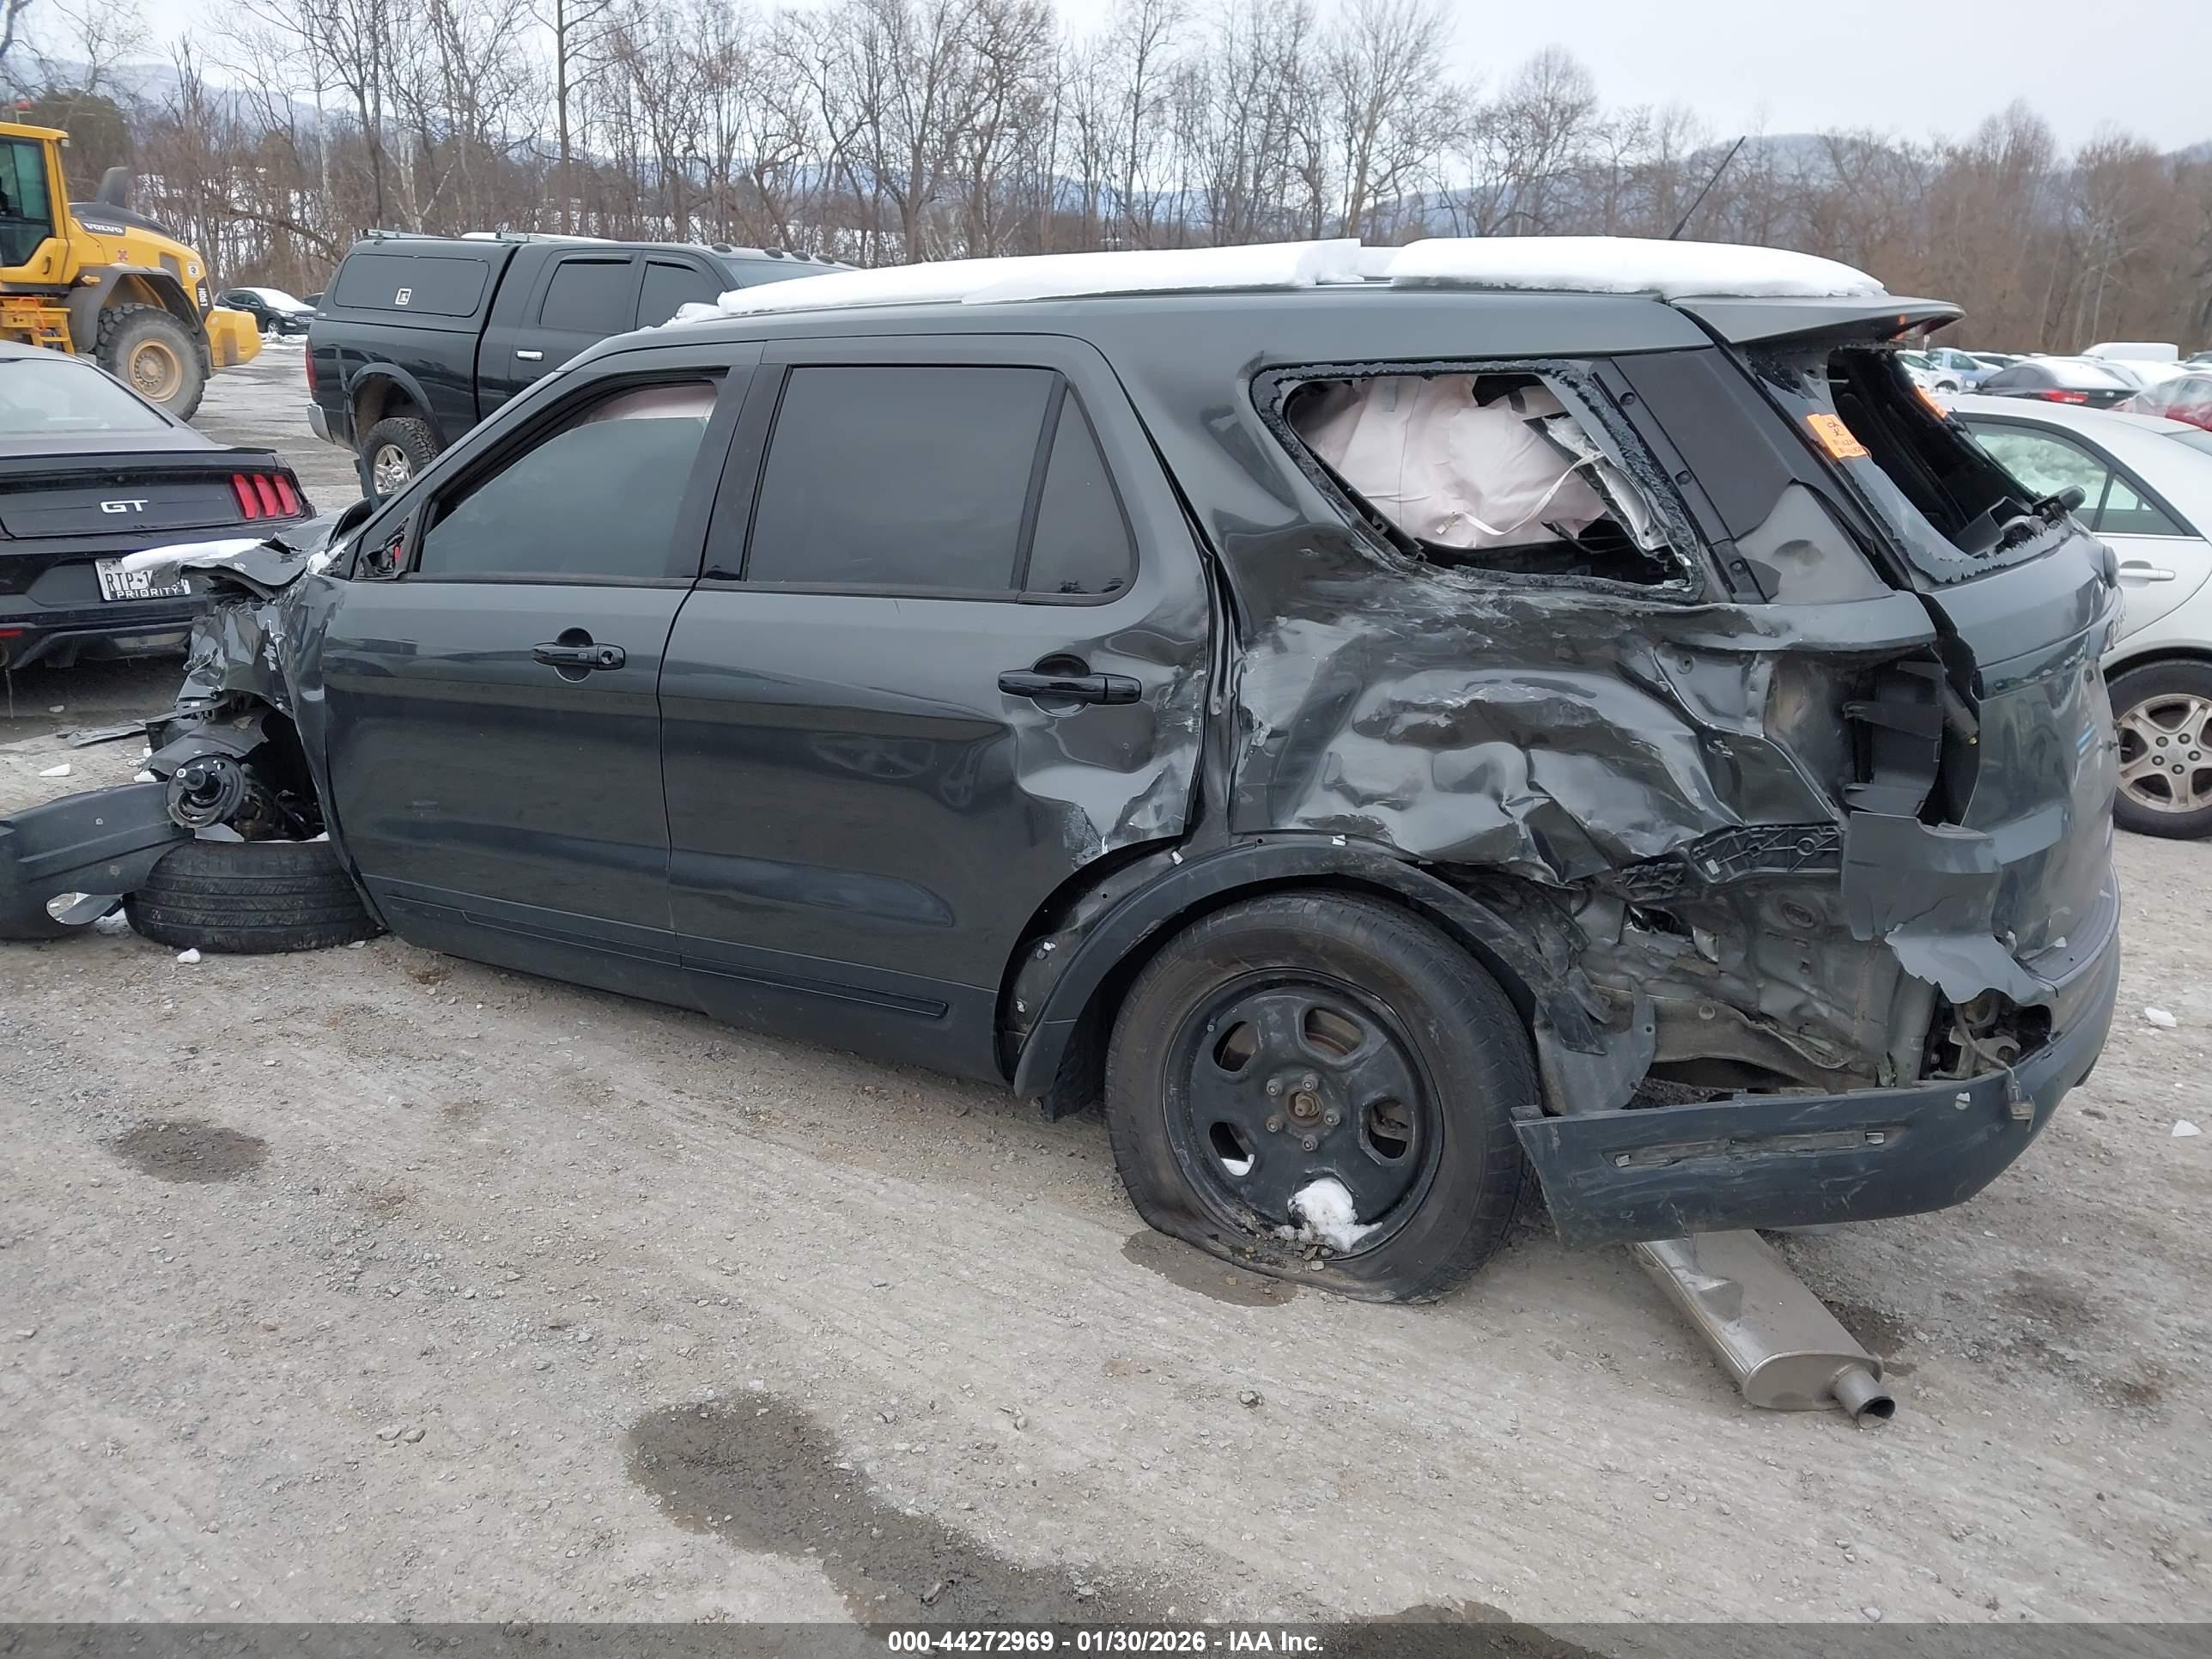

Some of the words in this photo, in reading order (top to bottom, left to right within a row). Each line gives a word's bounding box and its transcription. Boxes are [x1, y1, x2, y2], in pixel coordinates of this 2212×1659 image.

[83, 222, 124, 233] VOLVO
[198, 288, 209, 307] L90H
[100, 499, 149, 514] GT
[116, 586, 178, 599] PRIORITY
